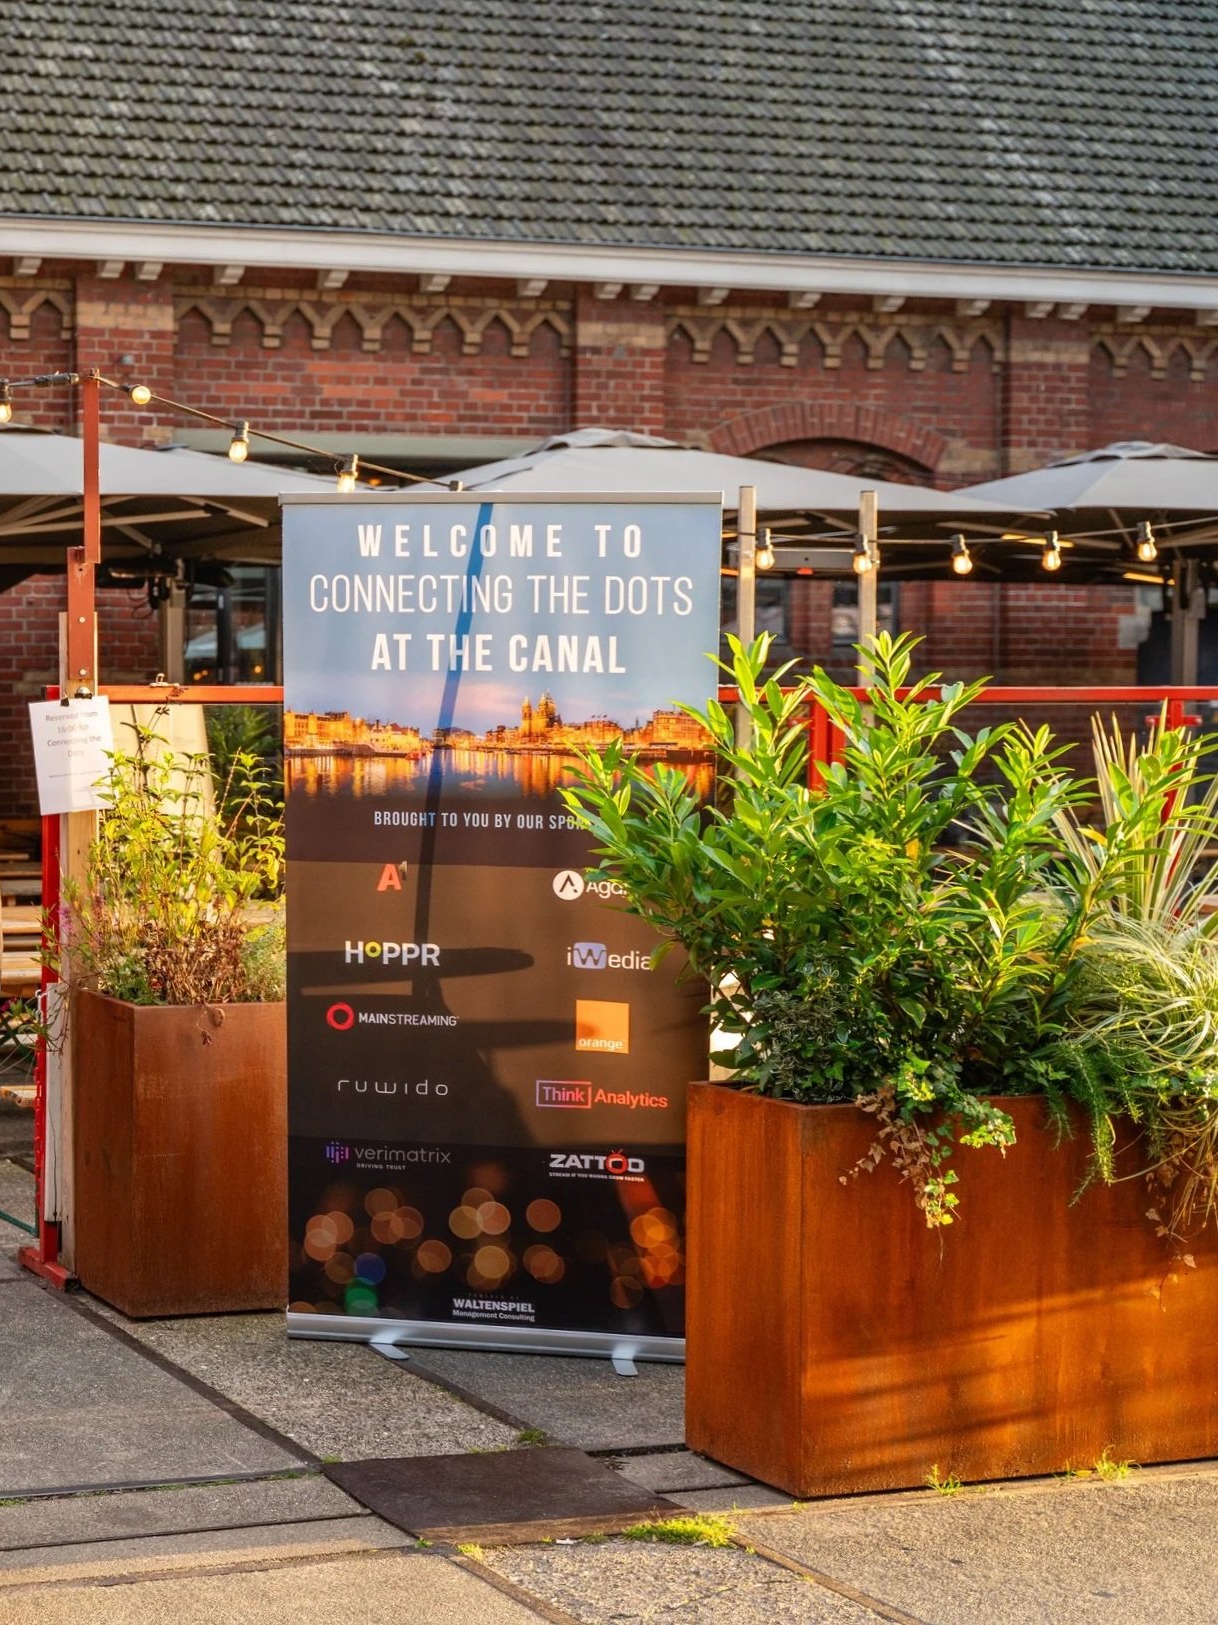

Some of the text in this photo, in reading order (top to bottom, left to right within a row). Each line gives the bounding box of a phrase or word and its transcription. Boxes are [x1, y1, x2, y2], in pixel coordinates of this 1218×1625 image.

[357, 524, 642, 558] WELCOME TO
[310, 574, 694, 616] CONNECTING THE DOTS
[370, 633, 627, 674] AT THE CANAL
[374, 811, 436, 827] BROUGHT
[441, 812, 458, 827] TO
[463, 813, 489, 828] YOU
[494, 814, 512, 828] BY
[517, 815, 543, 829] OUR
[345, 940, 441, 967] HOPPR
[567, 941, 651, 970] iWedia
[578, 1039, 623, 1051] orange
[337, 1080, 449, 1096] ruwido
[542, 1086, 669, 1109] Think Analytics
[354, 1145, 452, 1164] verimatrix
[548, 1152, 645, 1174] ZATTOO
[356, 1162, 384, 1170] DRIVING
[453, 1298, 536, 1313] WALTENSPIEL
[453, 1309, 536, 1323] Management Consulting
